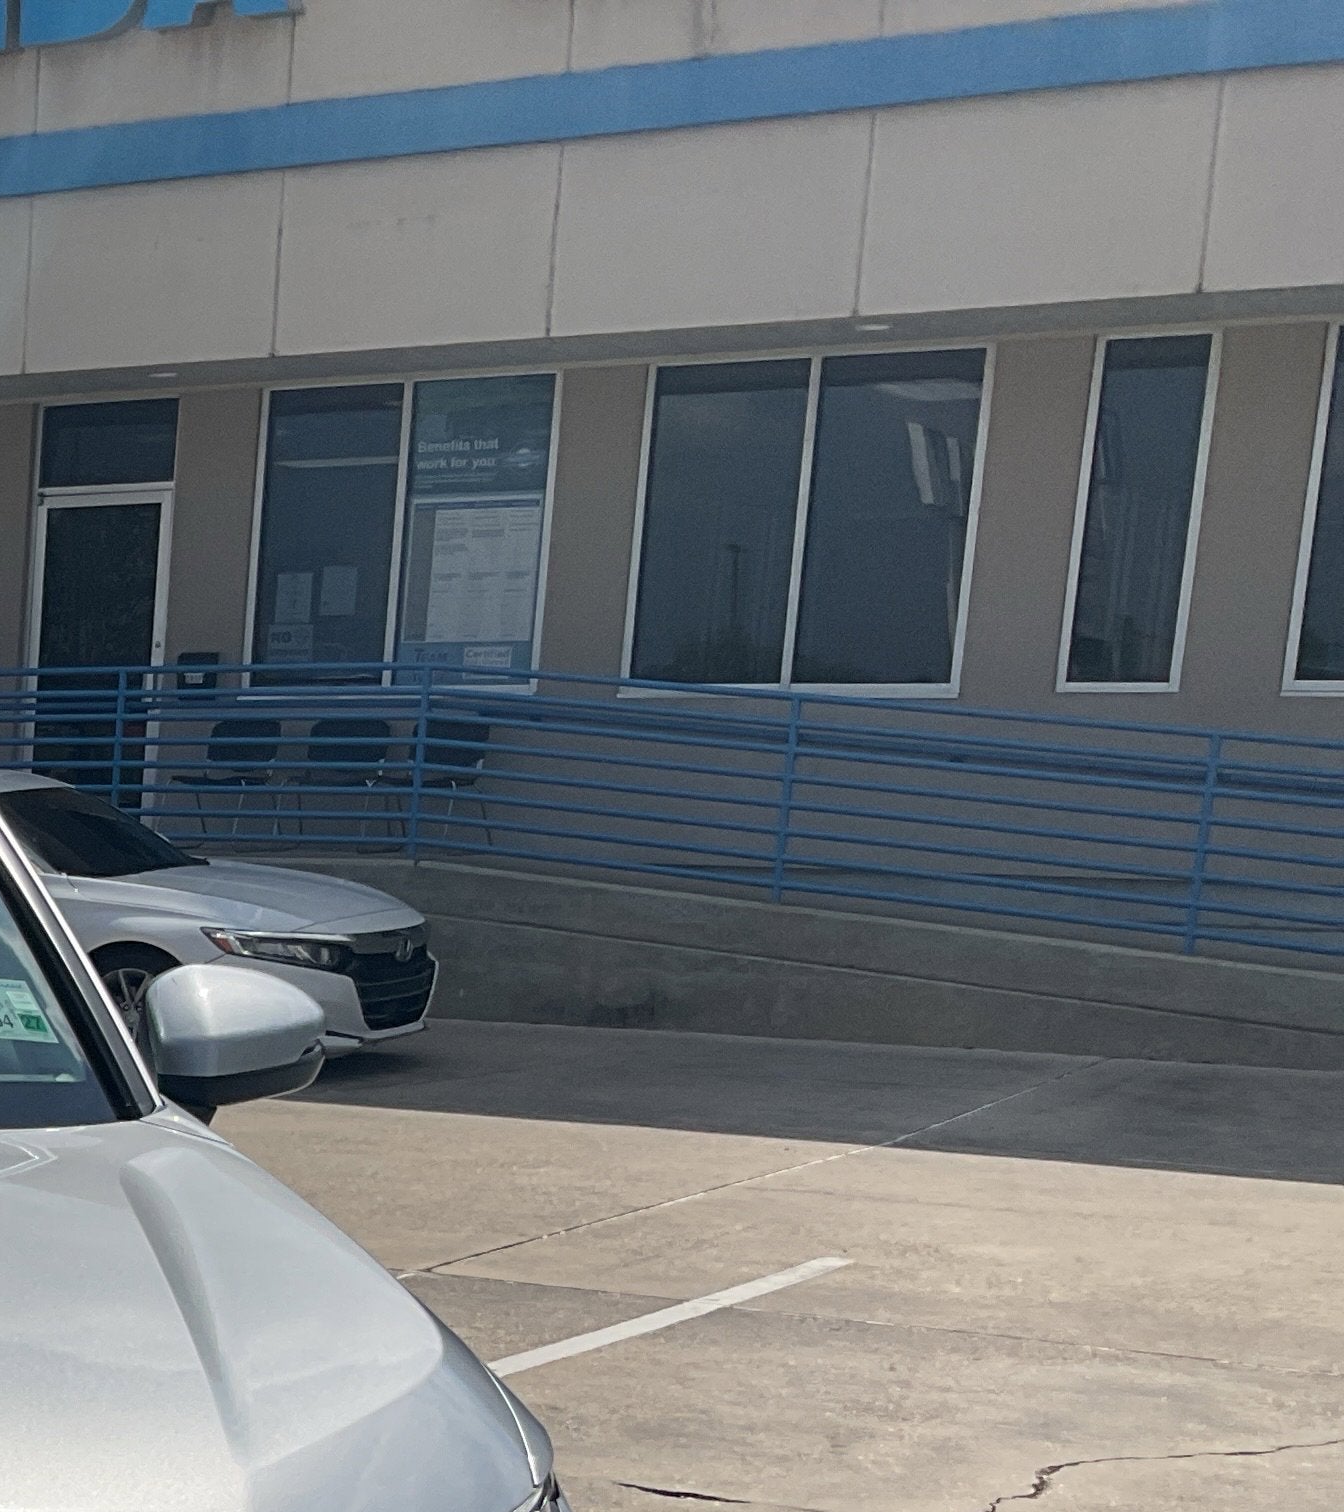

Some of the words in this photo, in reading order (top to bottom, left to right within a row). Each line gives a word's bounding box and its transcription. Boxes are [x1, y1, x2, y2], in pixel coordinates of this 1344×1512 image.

[417, 440, 471, 453] Benefits
[474, 438, 499, 450] that
[417, 459, 448, 470] work
[451, 457, 468, 468] for
[21, 1015, 43, 1030] 27
